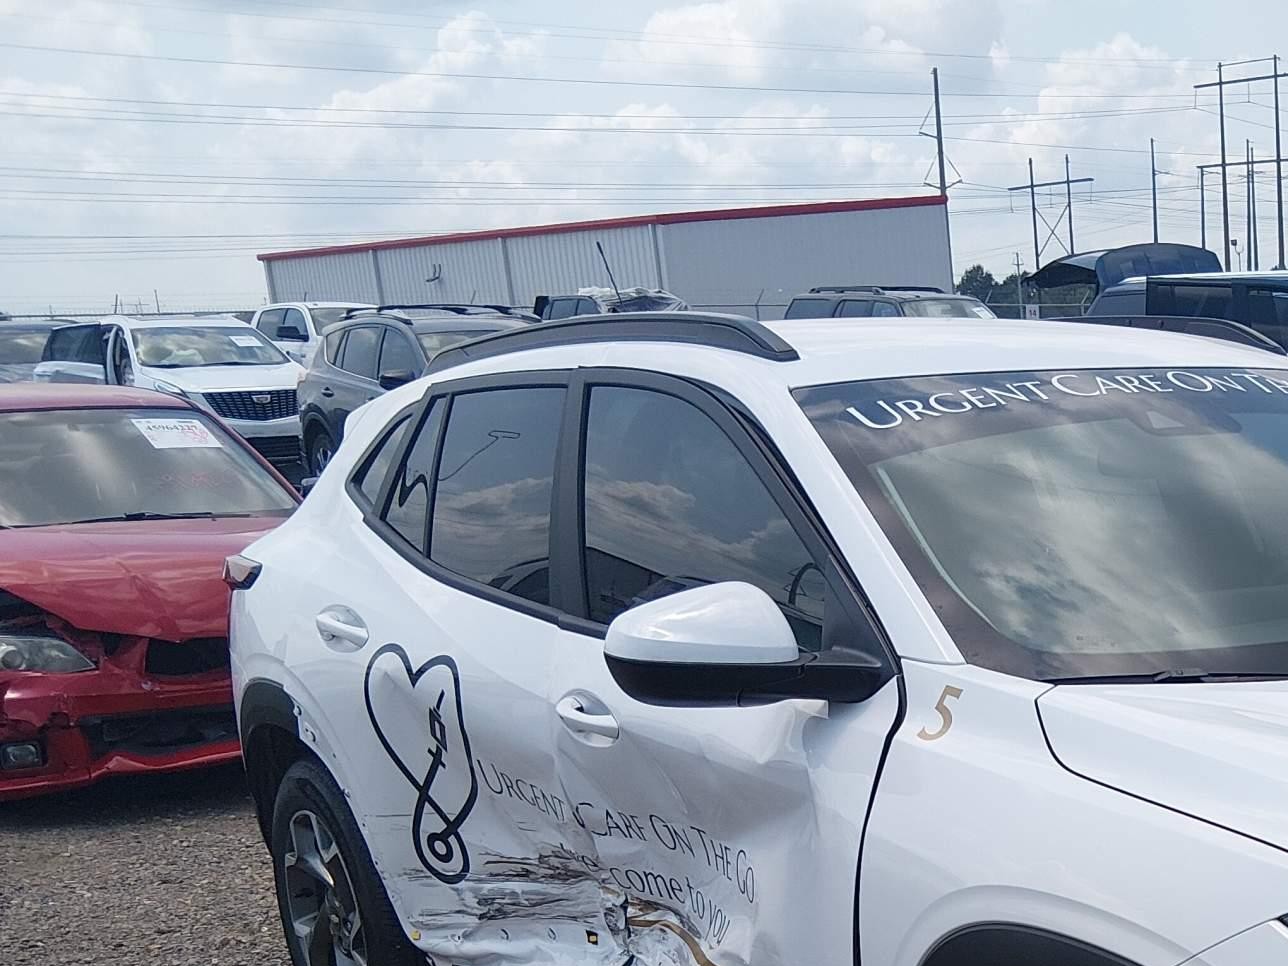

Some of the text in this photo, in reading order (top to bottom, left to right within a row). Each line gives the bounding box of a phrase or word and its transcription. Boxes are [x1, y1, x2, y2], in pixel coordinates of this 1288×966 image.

[846, 381, 1048, 429] URGENT
[1051, 374, 1173, 397] CARE
[1166, 371, 1247, 392] ON
[917, 685, 964, 740] 5
[477, 759, 565, 821] URGENT
[690, 825, 732, 881] THE
[736, 849, 755, 904] GO
[609, 867, 686, 904] come
[685, 876, 705, 920] to
[704, 899, 731, 946] you
